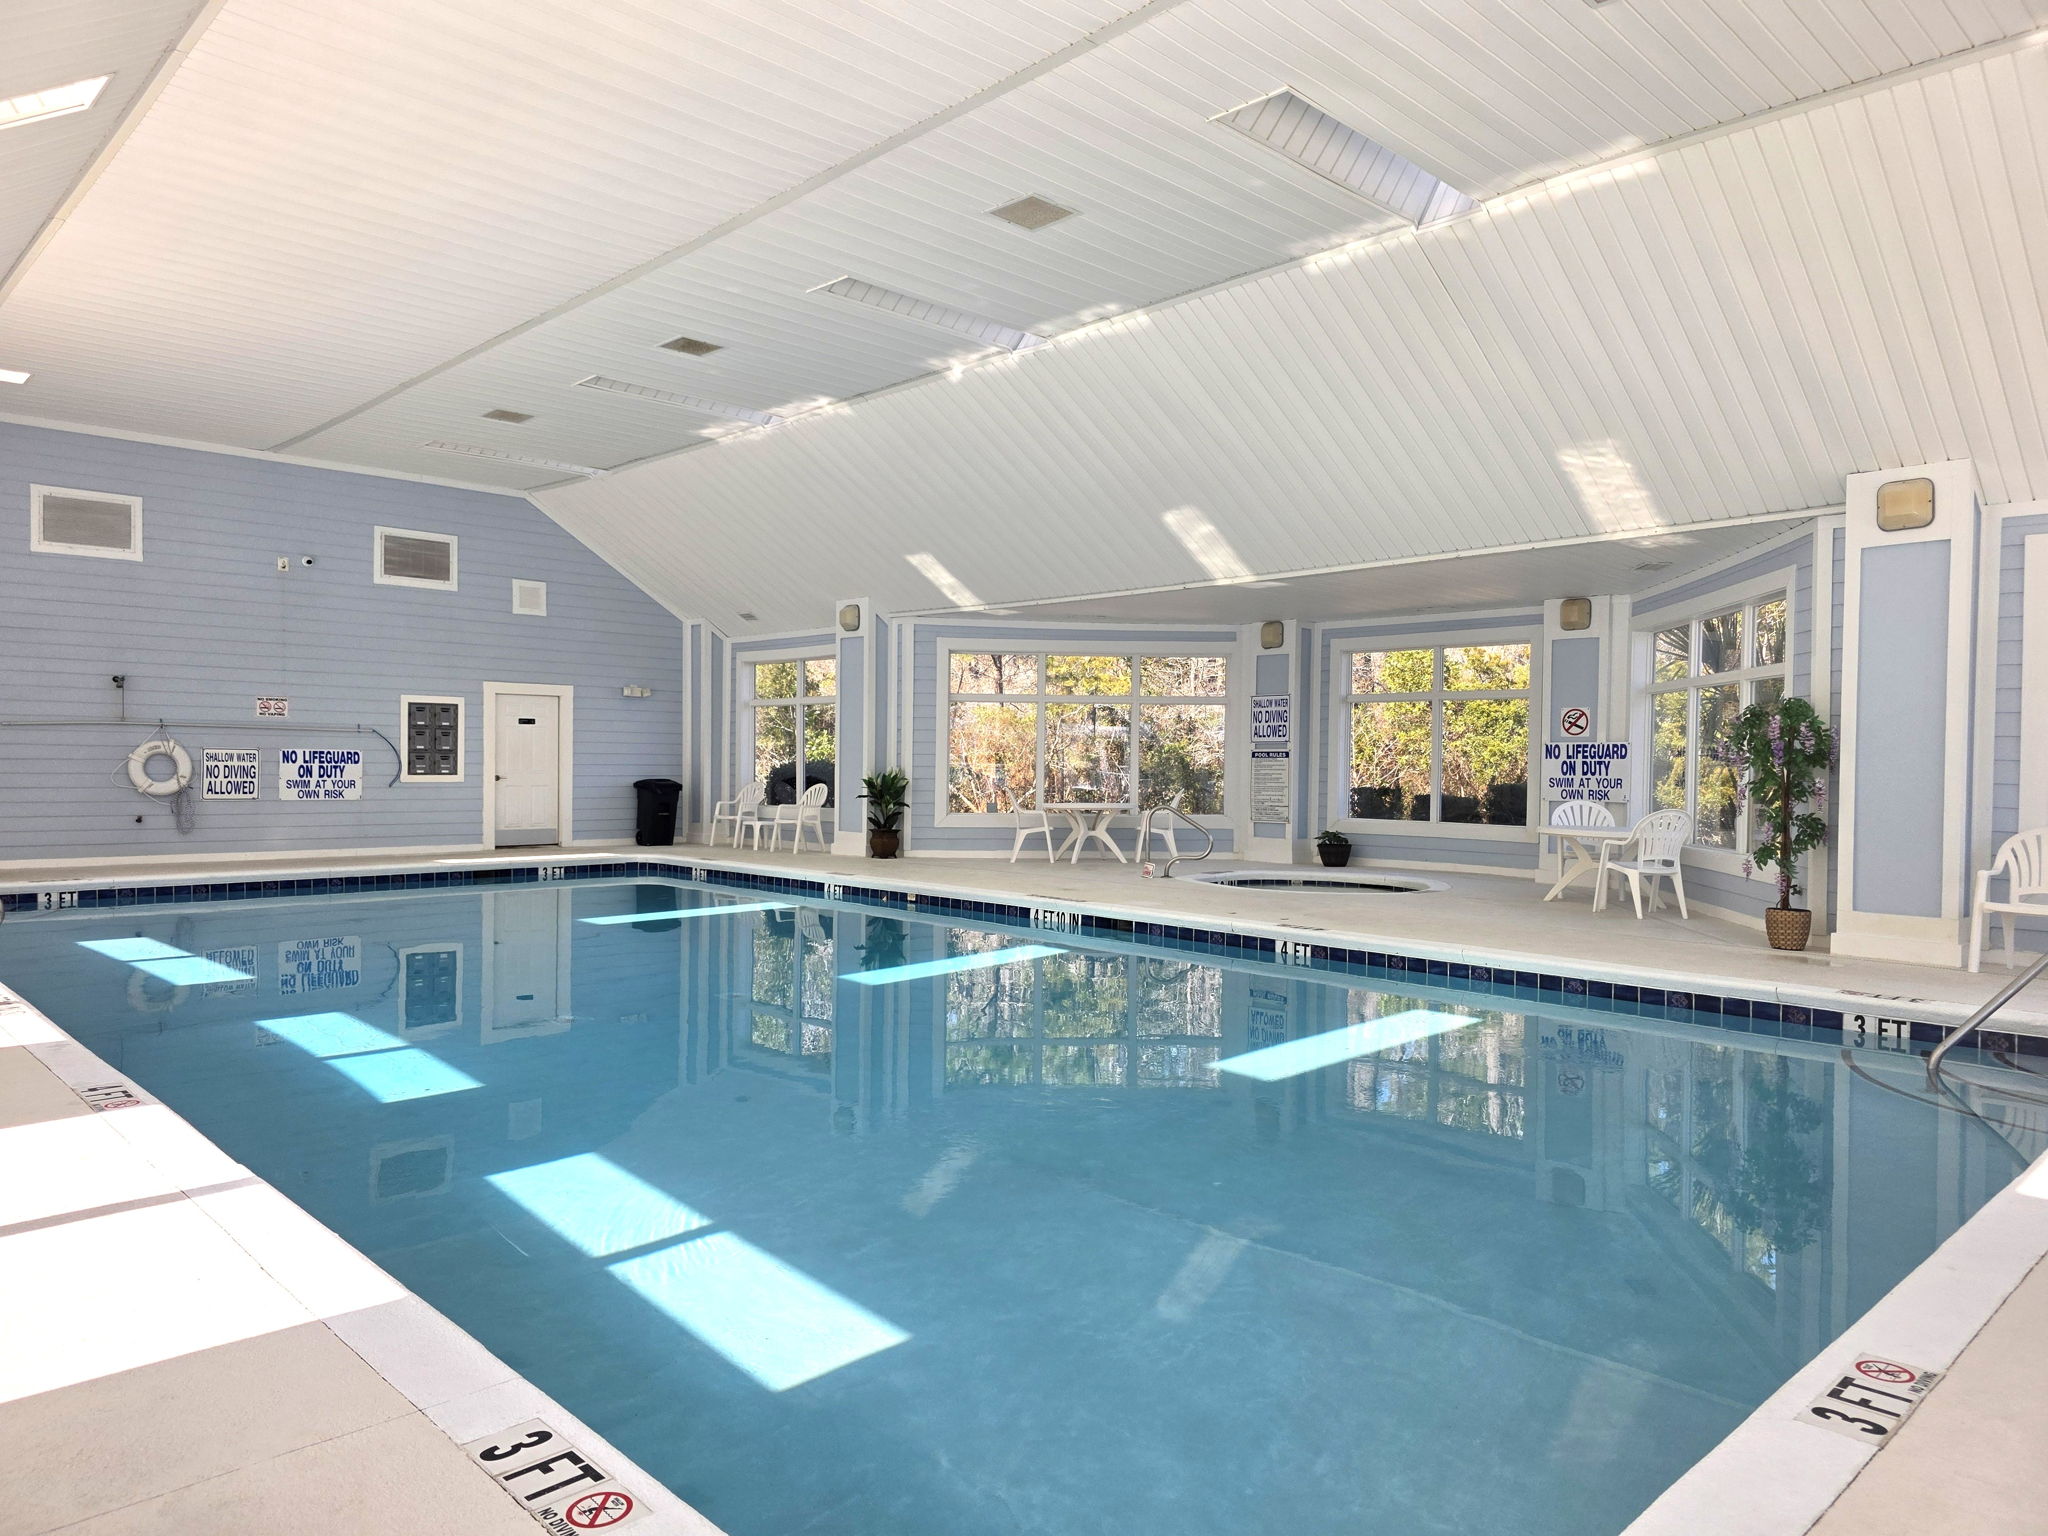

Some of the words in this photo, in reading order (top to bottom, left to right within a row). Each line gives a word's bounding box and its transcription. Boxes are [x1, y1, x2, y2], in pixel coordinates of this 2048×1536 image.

[1253, 699, 1273, 708] SHALLOW
[1274, 698, 1288, 708] WATER
[1253, 710, 1263, 724] NO
[1264, 709, 1288, 723] DIVING
[1253, 724, 1287, 738] ALLOWED
[205, 752, 234, 763] SHALLOW
[236, 752, 257, 762] WATER
[282, 750, 298, 764] NO
[302, 750, 360, 765] LIFEGUARD
[1545, 744, 1561, 760] NO
[1566, 744, 1628, 760] LIFEGUARD
[205, 764, 220, 779] NO
[223, 764, 257, 780] DIVING
[298, 765, 313, 778] ON
[318, 765, 346, 779] DUTY
[1560, 760, 1576, 776] ON
[1581, 760, 1611, 776] DUTY
[206, 780, 255, 795] ALLOWED
[286, 779, 311, 789] SWIM
[314, 779, 327, 789] AT
[331, 779, 356, 789] YOUR
[1548, 777, 1574, 789] SWIM
[1578, 778, 1591, 789] AT
[1595, 778, 1623, 789] YOUR
[297, 789, 320, 799] OWN
[323, 789, 345, 799] RISK
[1560, 789, 1584, 800] OWN
[1588, 789, 1610, 801] RISK
[543, 867, 548, 879] 3
[44, 892, 52, 907] 3
[1034, 908, 1039, 924] 4
[1056, 911, 1066, 928] 10
[1069, 912, 1080, 930] IN
[1281, 940, 1288, 957] 4
[1294, 942, 1310, 960] FT
[1853, 1014, 1866, 1037] 3
[1877, 1018, 1907, 1042] FT
[1826, 1375, 1914, 1418] FT
[1811, 1406, 1889, 1435] 3
[479, 1430, 553, 1462] 3
[502, 1450, 606, 1502] FT
[538, 1507, 558, 1520] NO
[549, 1518, 580, 1536] DIVIN
